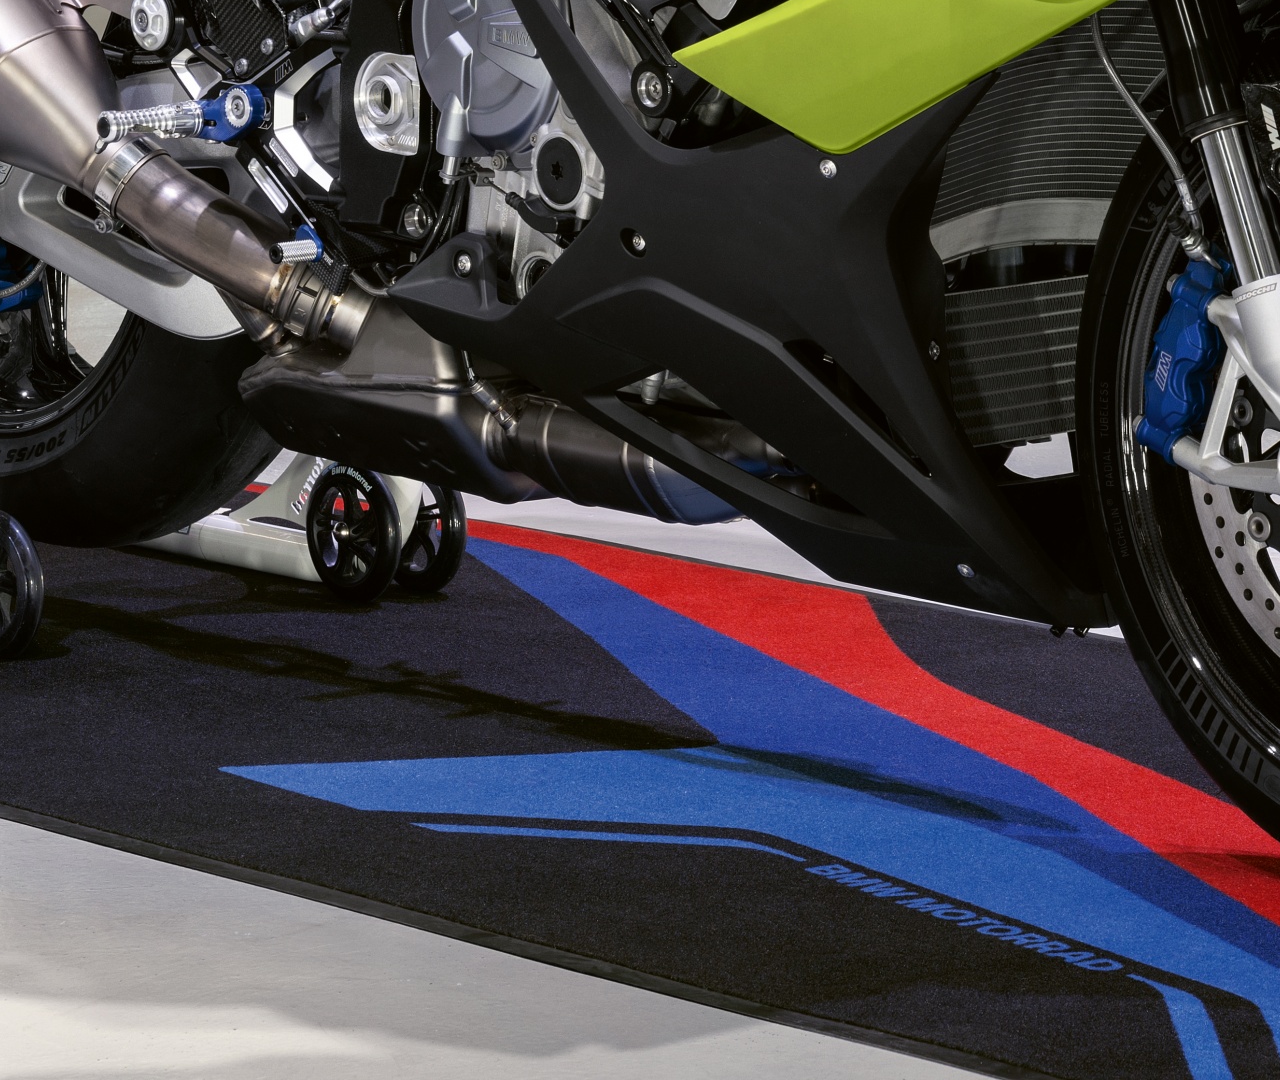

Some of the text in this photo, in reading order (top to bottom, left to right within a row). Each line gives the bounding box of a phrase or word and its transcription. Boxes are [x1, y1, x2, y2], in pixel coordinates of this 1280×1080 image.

[492, 27, 531, 47] BMW
[82, 321, 146, 430] CHELIN
[1099, 381, 1109, 437] TUBELESS
[4, 430, 68, 463] 200/55
[331, 466, 373, 492] BMW Motorrad
[1106, 448, 1115, 487] RADIAL
[805, 864, 1124, 971] BMW MOTORRAD
